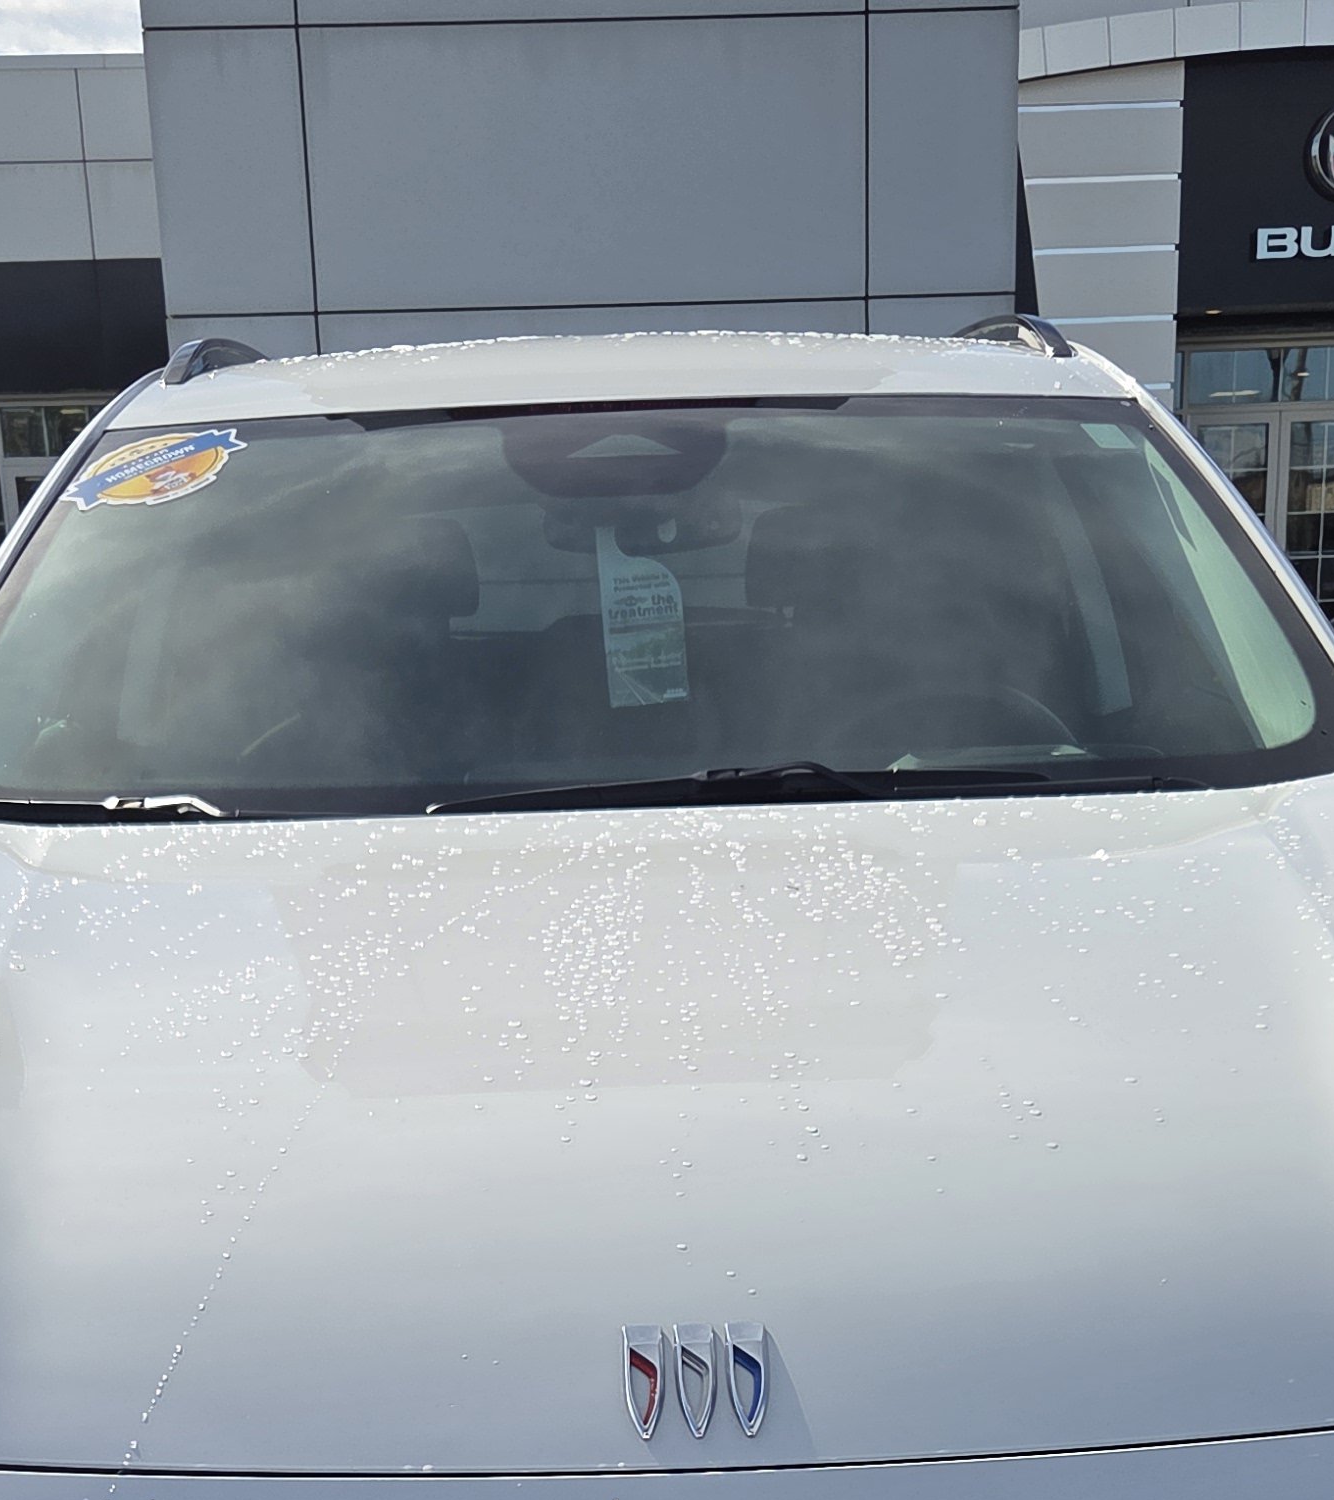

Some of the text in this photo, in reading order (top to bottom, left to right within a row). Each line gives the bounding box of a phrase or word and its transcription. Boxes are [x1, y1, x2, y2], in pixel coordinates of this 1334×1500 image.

[105, 444, 195, 483] HOMEGROWN
[651, 594, 675, 606] the
[607, 602, 679, 620] treatment
